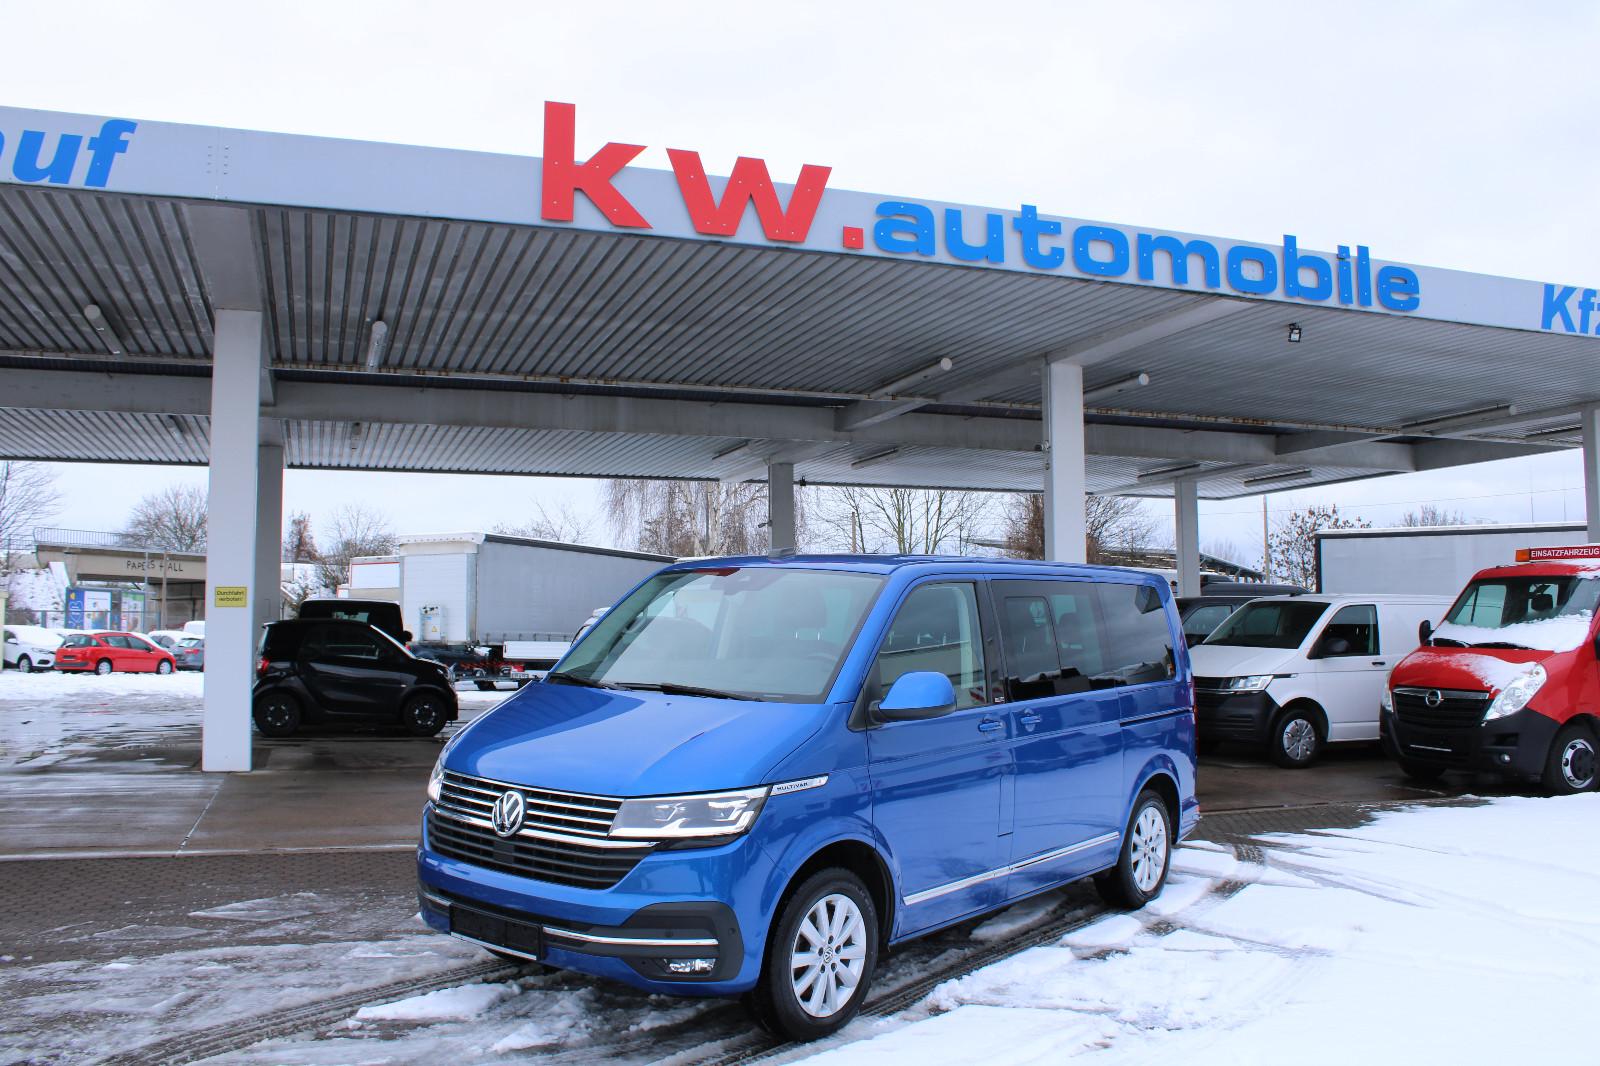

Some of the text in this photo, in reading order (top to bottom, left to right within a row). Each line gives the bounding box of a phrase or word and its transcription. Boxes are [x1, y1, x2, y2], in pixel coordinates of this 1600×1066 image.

[0, 119, 138, 188] uf
[1541, 283, 1600, 335] Kf
[1531, 548, 1600, 557] EINSATZFAHRZEUG
[126, 560, 156, 571] PAPES
[167, 562, 184, 572] ALL
[776, 782, 808, 791] MULTIVAN
